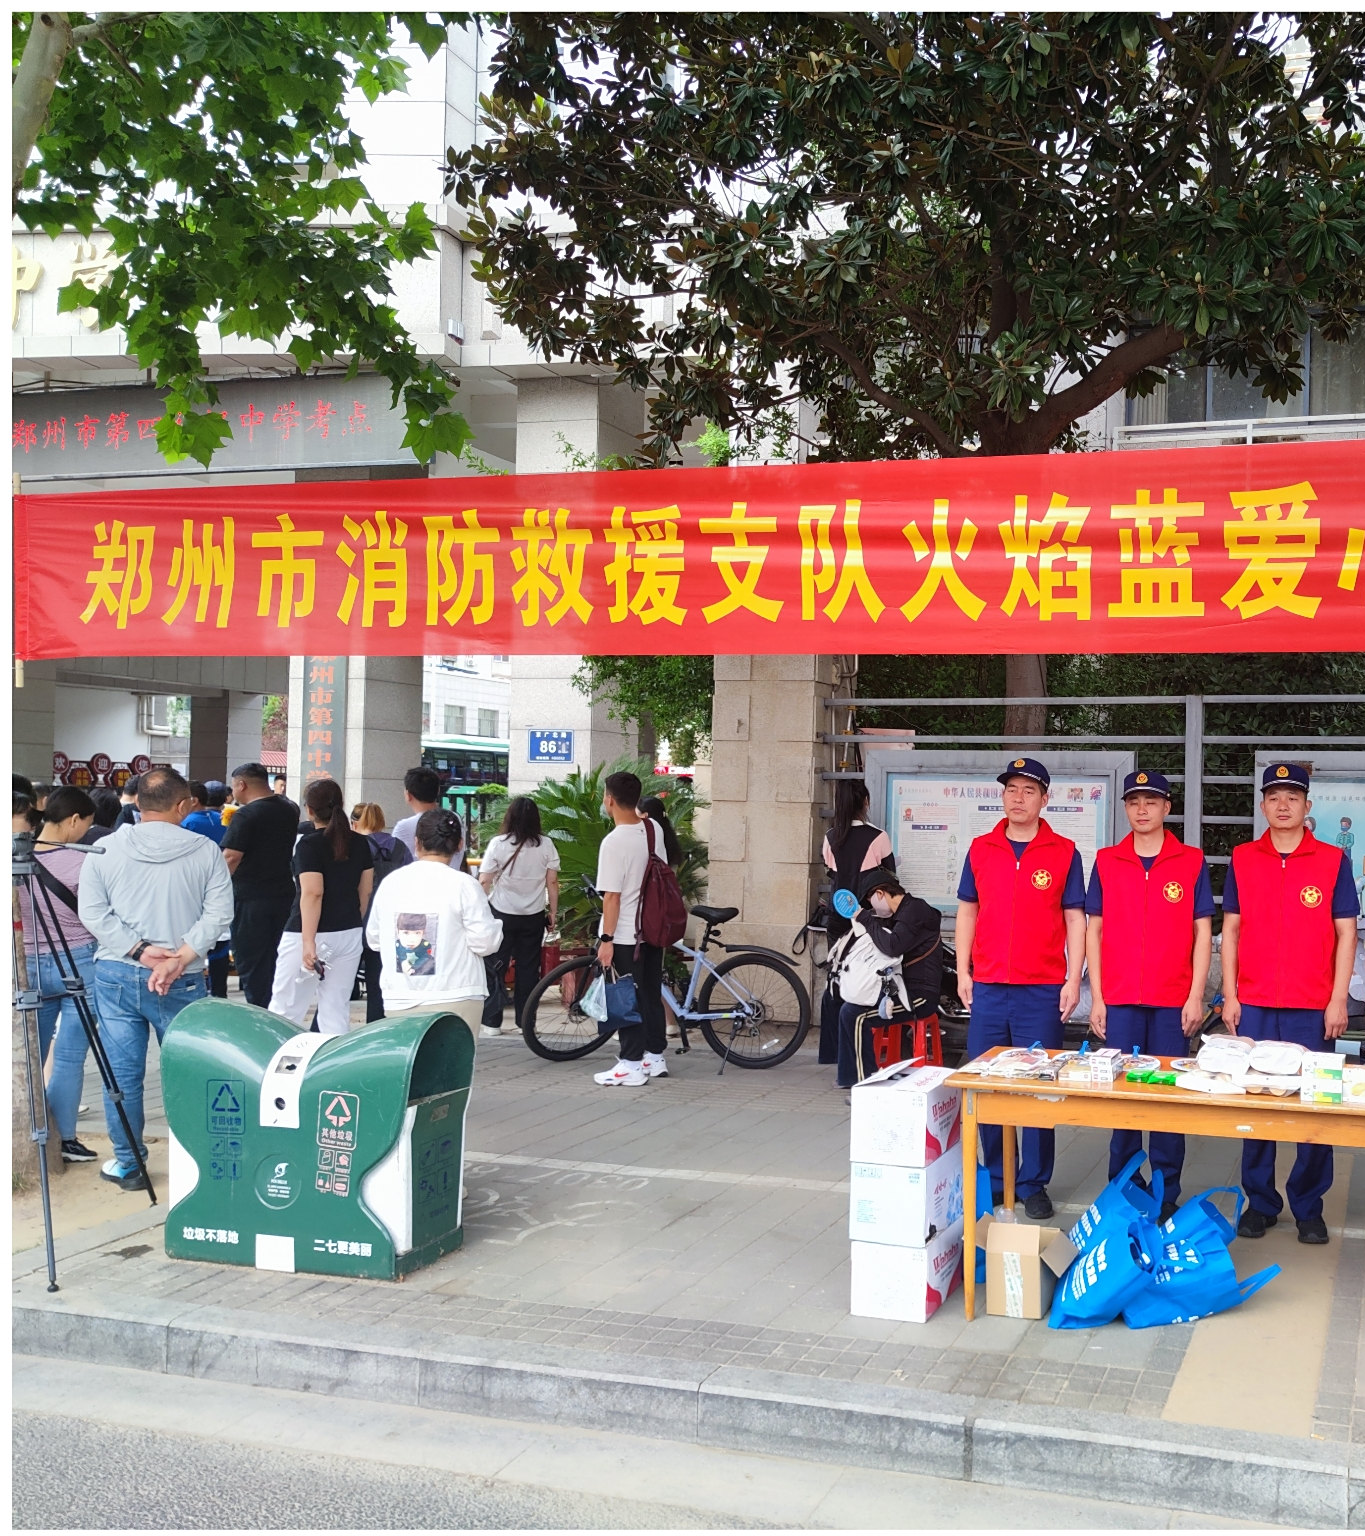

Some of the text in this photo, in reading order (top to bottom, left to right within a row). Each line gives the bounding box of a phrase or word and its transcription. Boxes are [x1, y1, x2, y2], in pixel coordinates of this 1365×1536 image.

[13, 399, 373, 454] 郑州市第四中学考点
[540, 740, 557, 753] 86
[211, 1115, 242, 1127] 可回收物
[321, 1127, 353, 1142] 其他垃圾
[182, 1226, 239, 1244] 垃圾不落地
[313, 1239, 372, 1257] 二七更美丽
